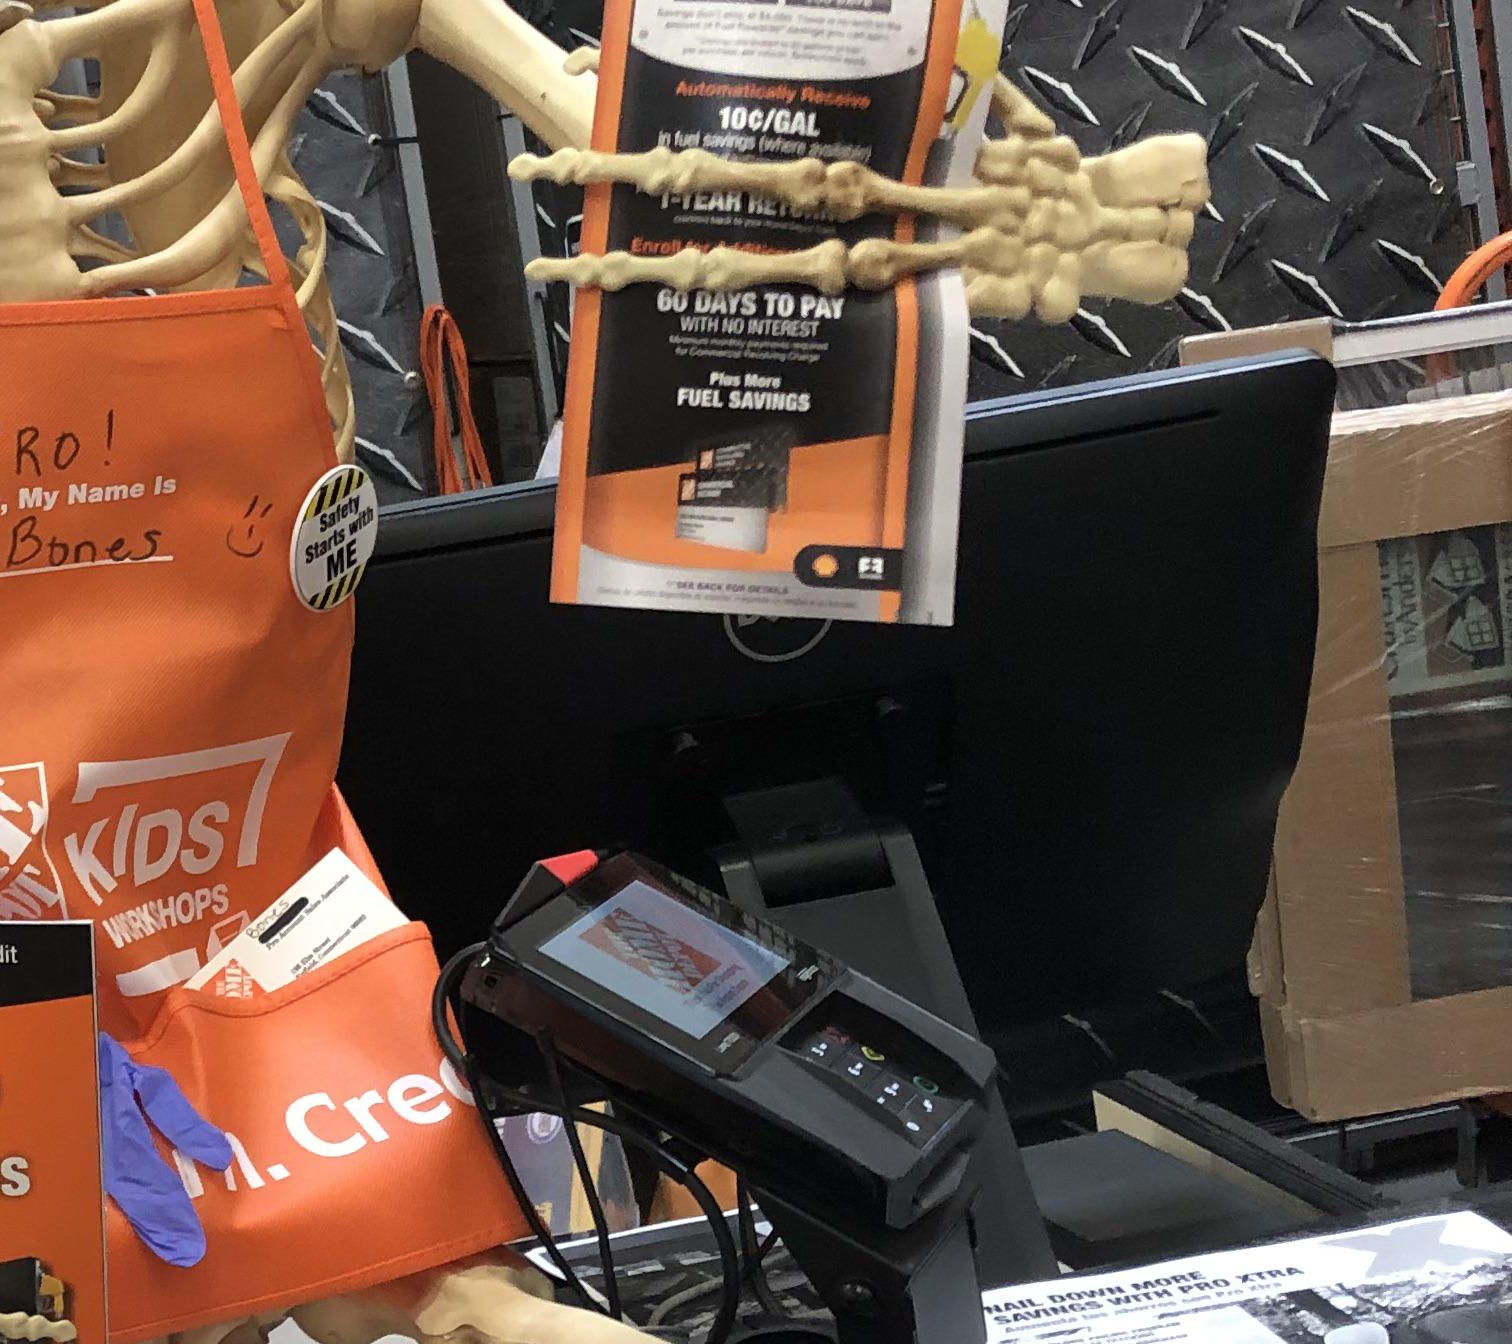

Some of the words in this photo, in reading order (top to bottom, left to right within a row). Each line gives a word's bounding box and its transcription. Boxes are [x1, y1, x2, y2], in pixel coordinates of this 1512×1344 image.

[676, 79, 799, 105] Automatically
[718, 105, 821, 137] 10¢/GAL
[674, 129, 701, 148] fuel
[702, 132, 757, 153] savings
[656, 288, 688, 313] 60
[694, 291, 758, 317] DAYS
[763, 292, 796, 318] TO
[800, 294, 846, 320] PAY
[680, 316, 719, 334] WITH
[721, 318, 744, 335] NO
[747, 319, 821, 339] INTEREST
[676, 387, 724, 409] FUEL
[728, 390, 812, 413] SAVINGS
[709, 371, 741, 388] Plus
[744, 373, 783, 390] More
[17, 486, 61, 514] My
[67, 481, 146, 506] Name
[154, 475, 178, 498] Is
[319, 493, 362, 533] Safety
[5, 515, 163, 569] Bones
[304, 525, 349, 564] Starts
[346, 505, 377, 537] with
[325, 536, 359, 584] ME
[63, 799, 230, 906] KIDS
[102, 883, 230, 950] WORKSHOPS
[984, 1299, 1044, 1315] NAIL
[1047, 1284, 1126, 1304] DOWN
[1130, 1270, 1207, 1292] MORE
[993, 1301, 1104, 1325] SAVINGS
[1107, 1287, 1174, 1308] WITH
[1178, 1278, 1231, 1297] PRO
[1237, 1266, 1305, 1285] XTRA
